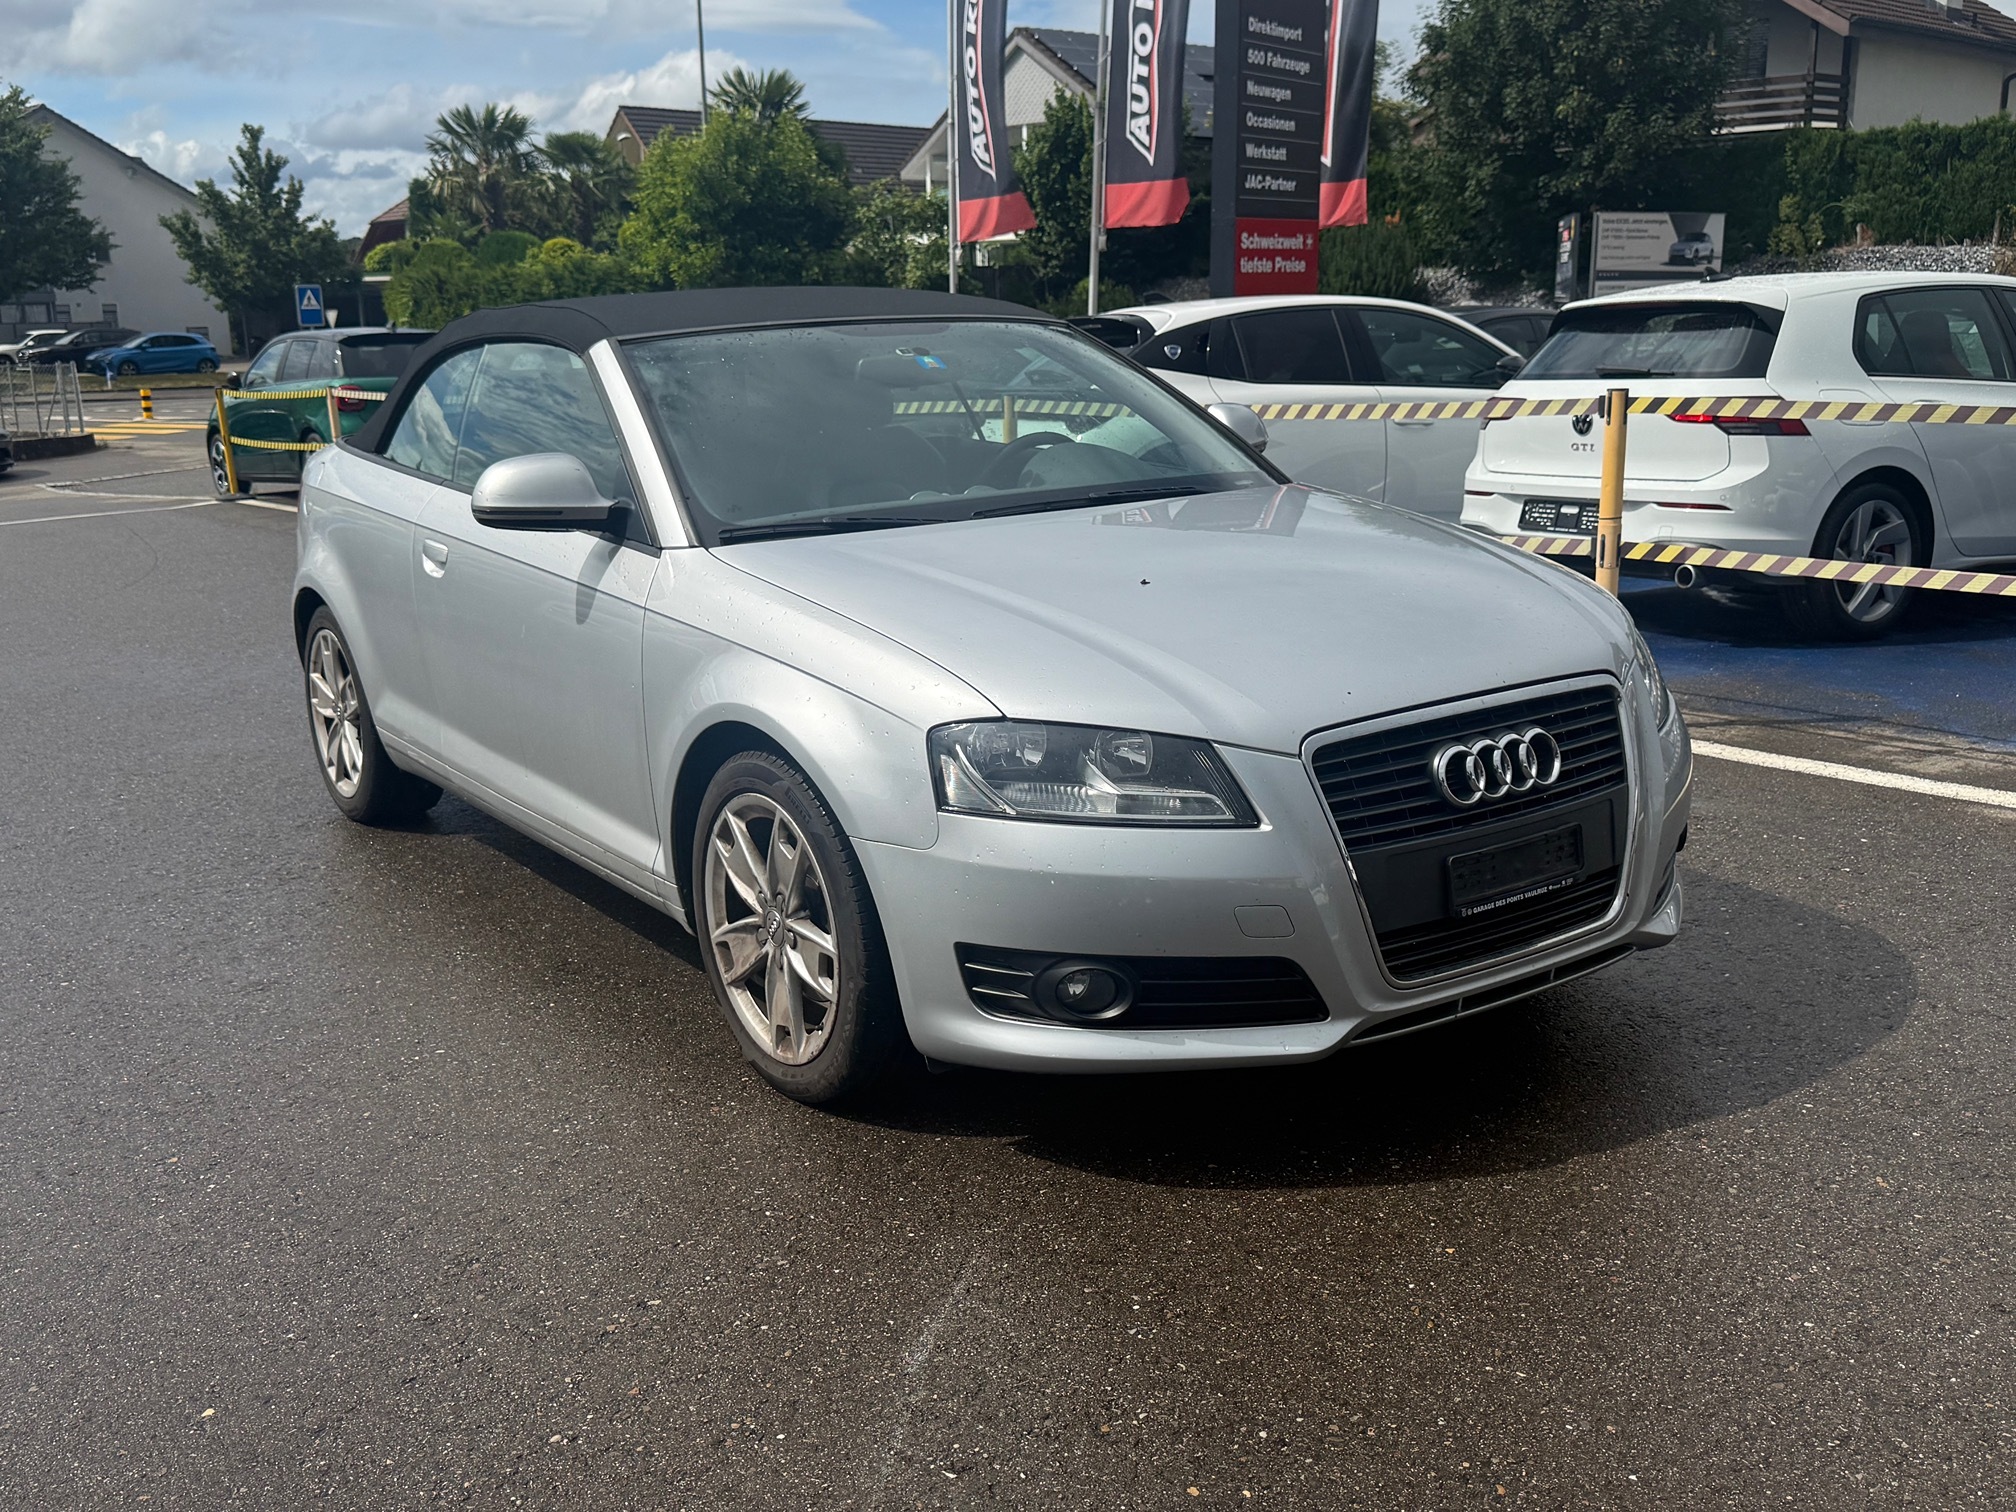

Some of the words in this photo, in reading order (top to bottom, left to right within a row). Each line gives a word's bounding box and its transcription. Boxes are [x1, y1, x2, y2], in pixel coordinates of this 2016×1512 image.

[966, 0, 979, 35] K
[1248, 16, 1302, 41] Direktimport
[1247, 48, 1265, 66] 500
[1266, 51, 1311, 75] Fahrzeuge
[1130, 22, 1154, 148] AUTO
[1246, 80, 1292, 102] Neuwagen
[965, 46, 992, 165] AUTO
[1246, 111, 1296, 132] Occasionen
[1245, 143, 1287, 161] Werkstatt
[1244, 174, 1297, 192] JAC-Partner
[1240, 231, 1304, 250] Schweizweit
[1240, 256, 1273, 273] tiefste
[1275, 256, 1306, 273] Preise
[1571, 442, 1595, 452] GTI
[1473, 902, 1495, 914] GARAGE
[1495, 898, 1507, 908] DES
[1506, 893, 1524, 904] PONTS
